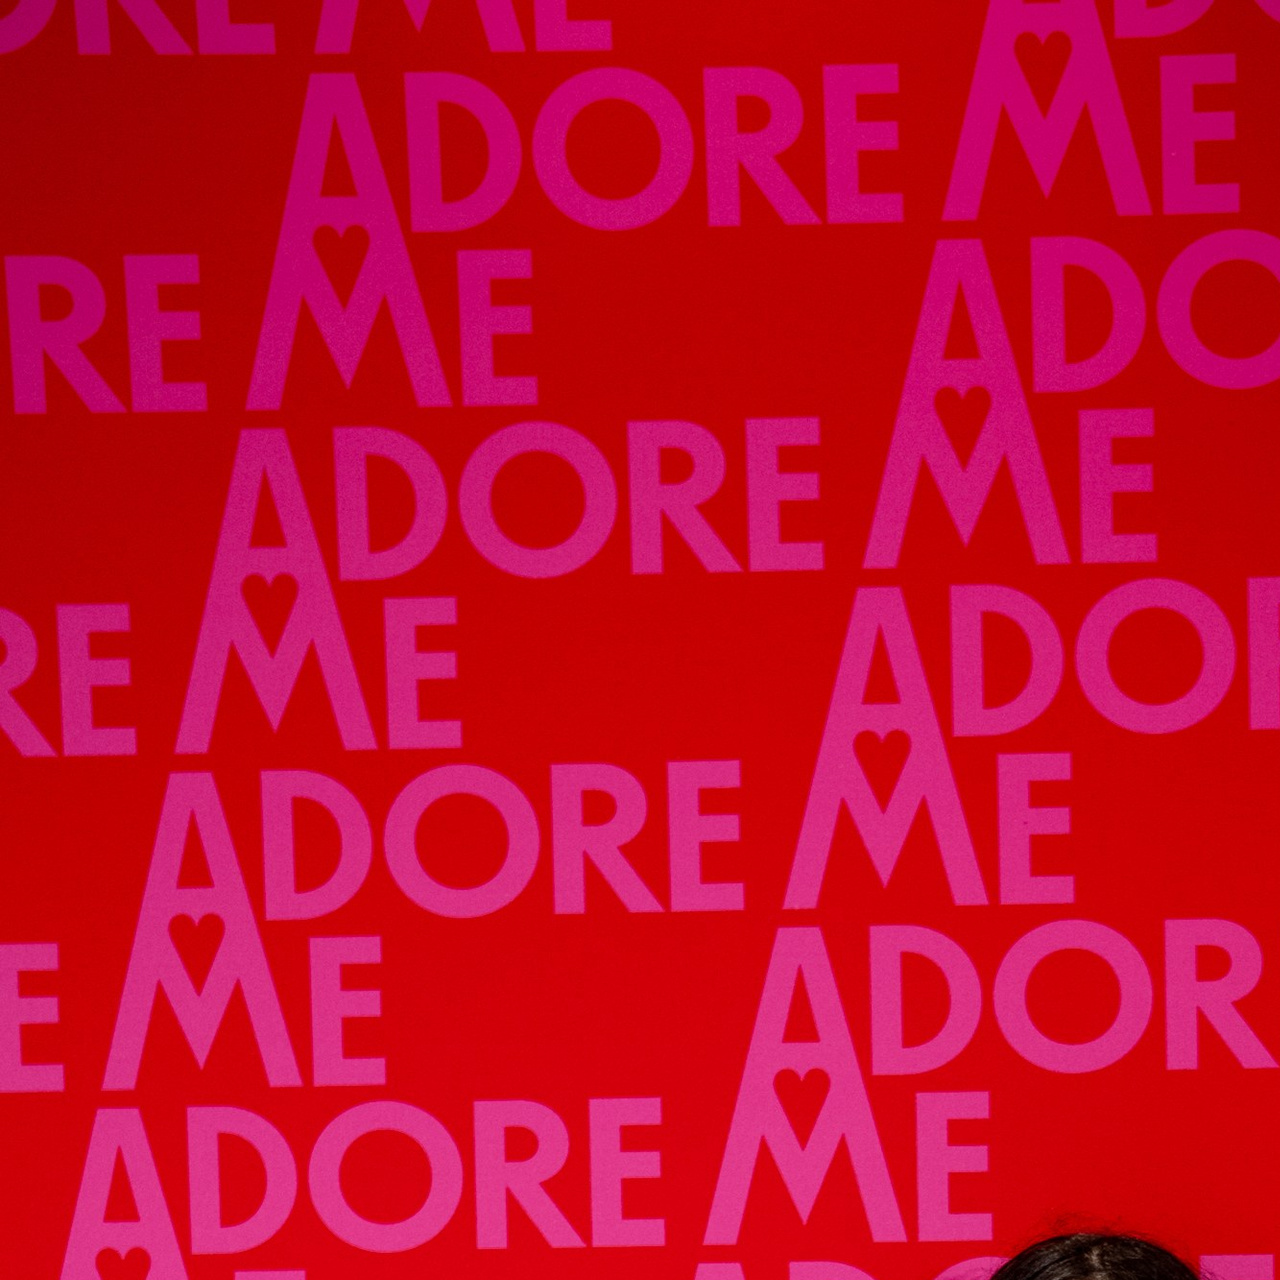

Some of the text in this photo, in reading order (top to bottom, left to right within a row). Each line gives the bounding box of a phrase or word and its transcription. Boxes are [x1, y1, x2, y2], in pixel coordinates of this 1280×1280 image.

[280, 63, 904, 232] ADORE
[942, 30, 1240, 221] ME
[246, 224, 538, 410] ME
[210, 416, 825, 581] ADORE
[862, 385, 1158, 569] ME
[174, 573, 463, 754] ME
[137, 759, 745, 921] ADORE
[782, 729, 1076, 910] ME
[101, 913, 387, 1091] ME
[64, 1096, 666, 1255] ADORE
[703, 1068, 994, 1246] ME
